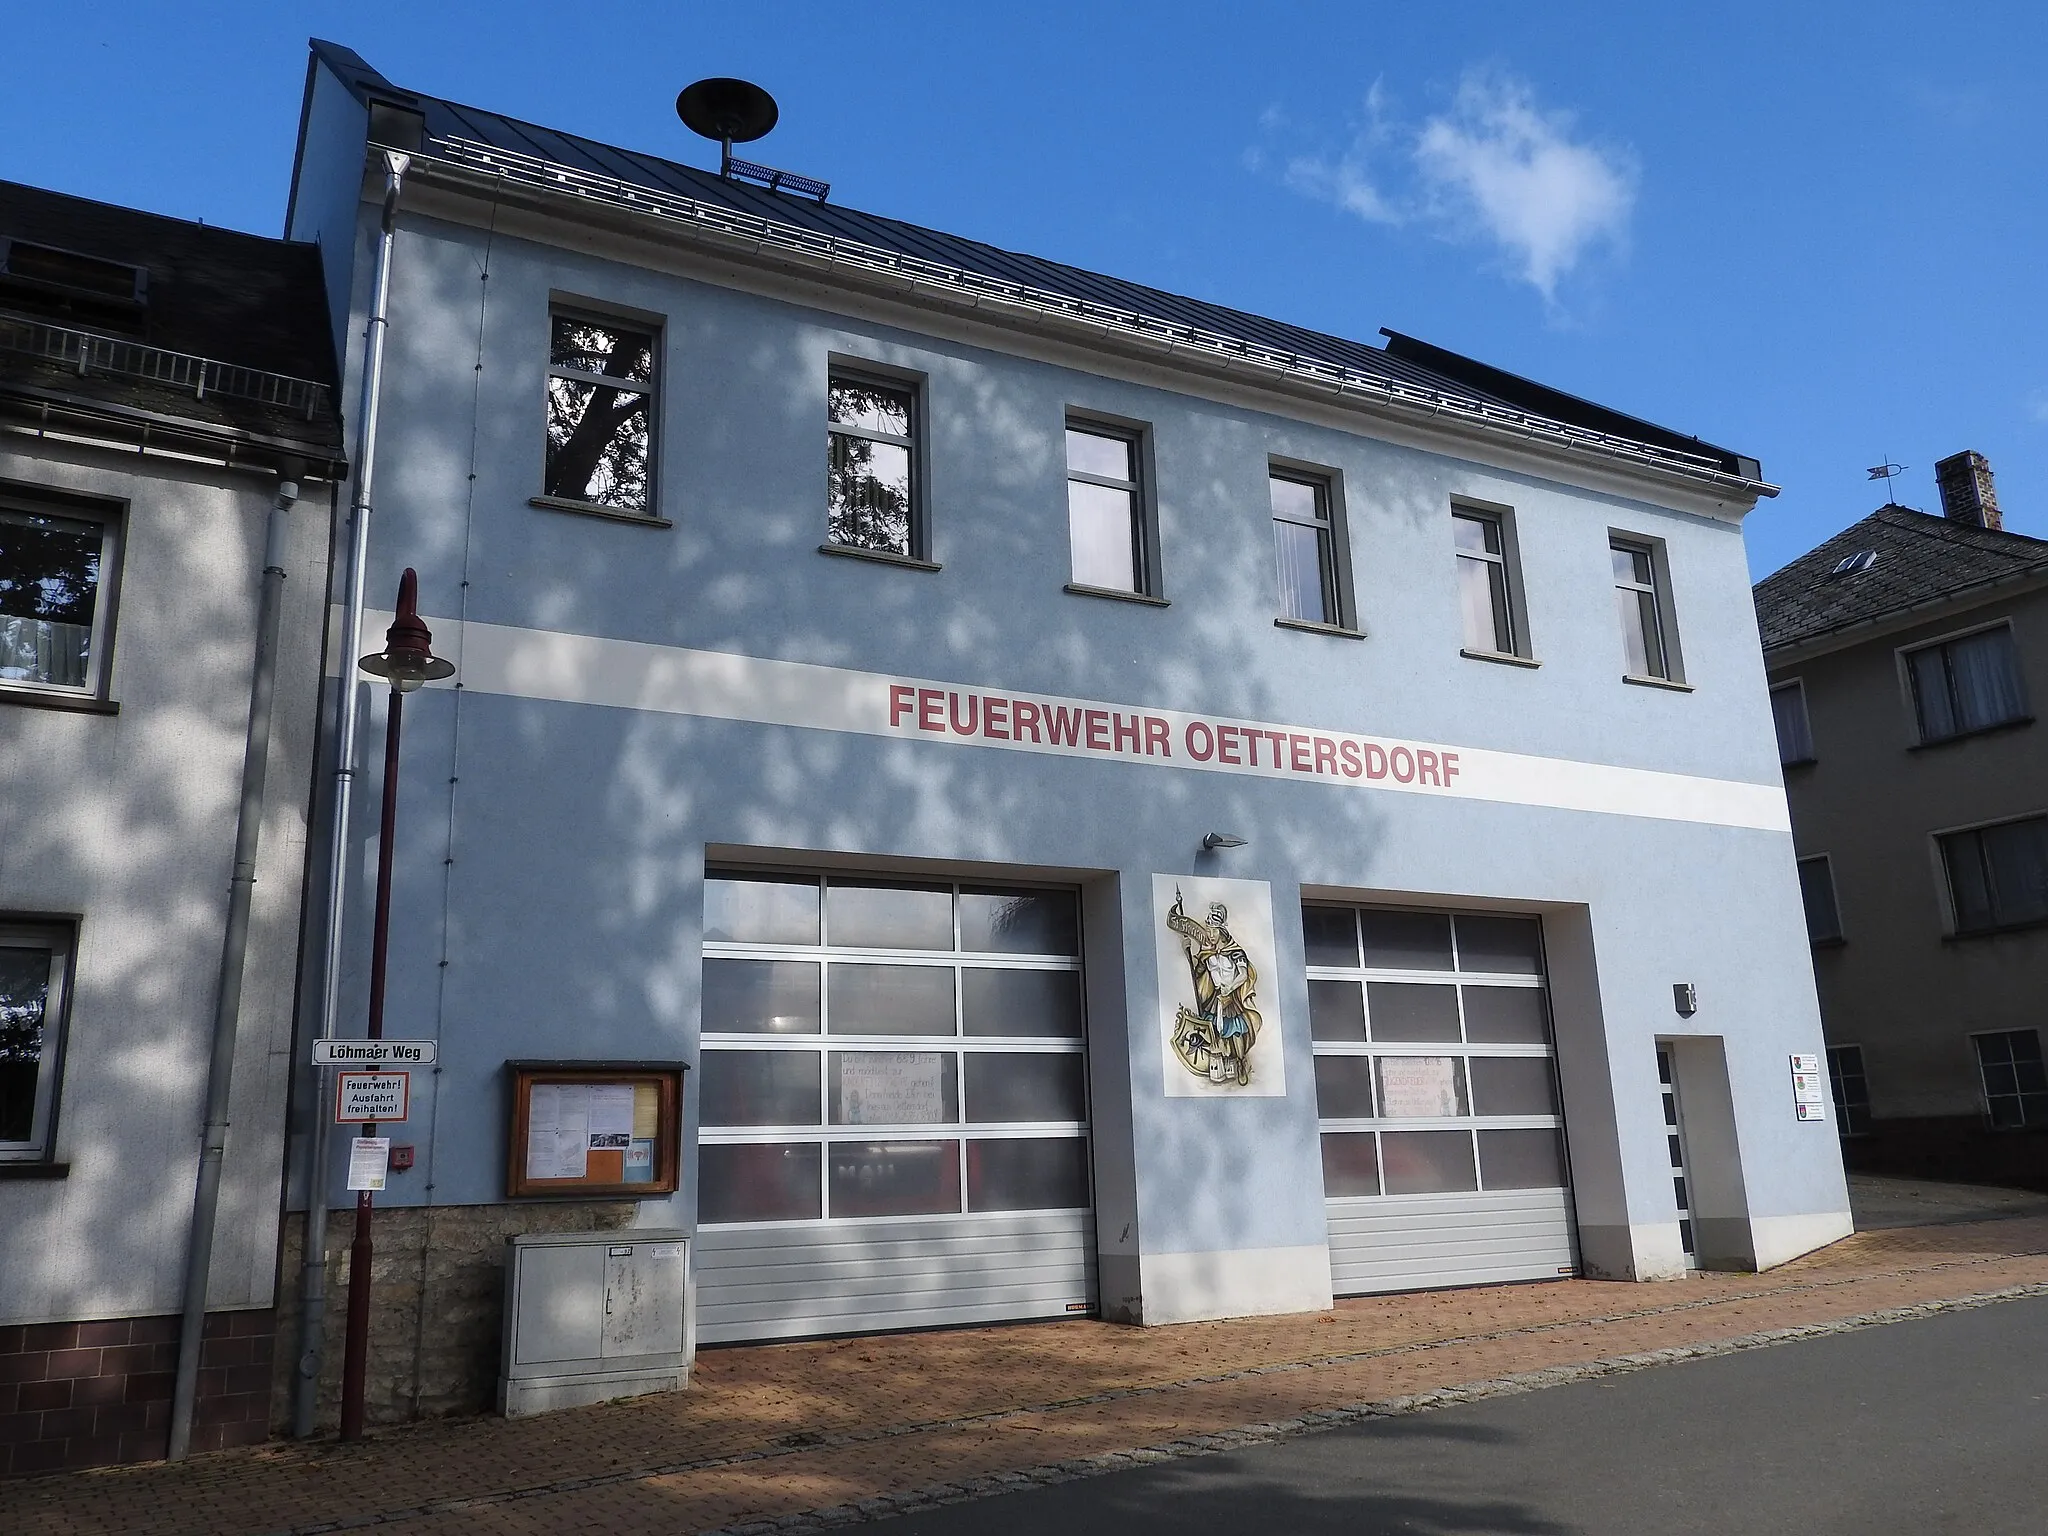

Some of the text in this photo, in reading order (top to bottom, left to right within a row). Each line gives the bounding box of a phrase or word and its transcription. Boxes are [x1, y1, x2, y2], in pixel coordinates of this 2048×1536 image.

[889, 684, 1460, 787] FEUERWEHR OETTERSDORF
[329, 1045, 421, 1061] Löhmaer Weg
[347, 1080, 401, 1089] Feuerwehr!
[352, 1093, 394, 1102] Ausfahrt
[347, 1104, 398, 1113] freihalten!
